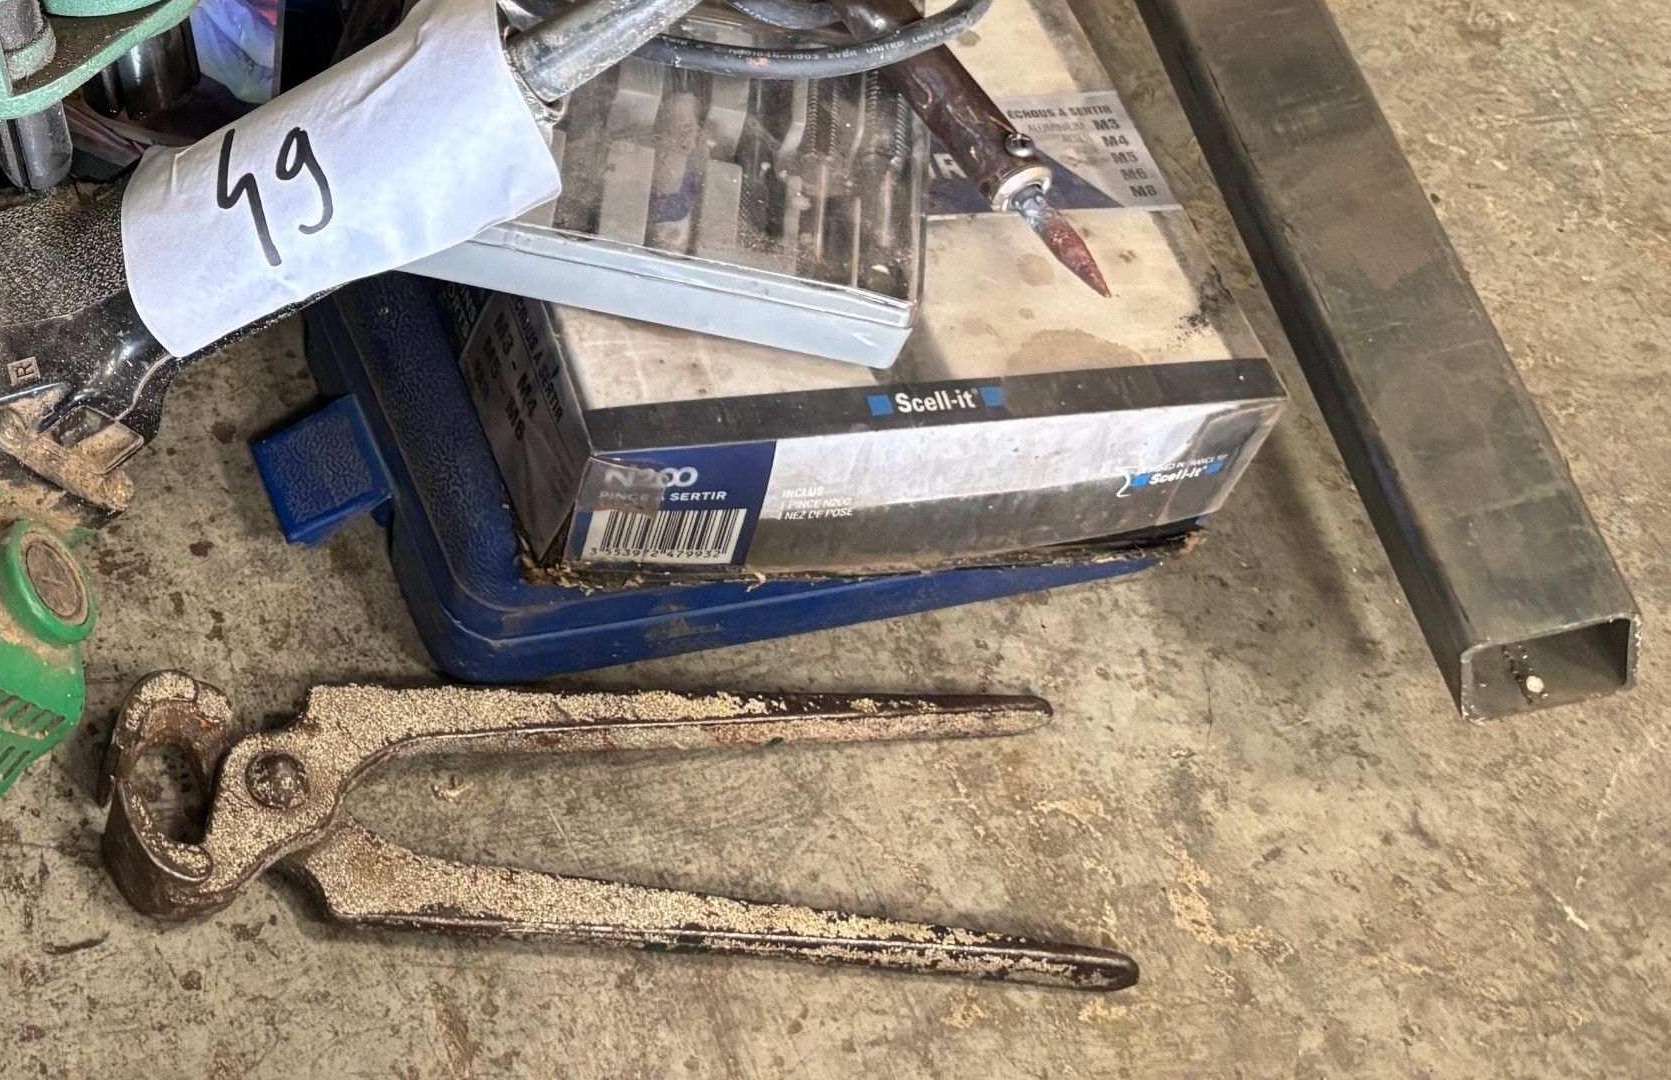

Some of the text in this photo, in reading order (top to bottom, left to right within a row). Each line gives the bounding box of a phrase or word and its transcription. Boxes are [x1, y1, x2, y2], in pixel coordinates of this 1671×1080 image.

[1092, 118, 1120, 131] M3
[1101, 134, 1130, 147] M4
[1110, 151, 1138, 164] M5
[1120, 168, 1147, 180] M6
[494, 311, 513, 355] M3
[517, 372, 537, 417] M4
[895, 389, 977, 413] Scell-it
[604, 467, 698, 488] N200
[1149, 466, 1206, 485] Scell-it
[670, 490, 727, 502] SERTIR
[782, 486, 824, 498] INCLUS
[787, 499, 821, 510] PINCE
[785, 511, 805, 520] NEZ
